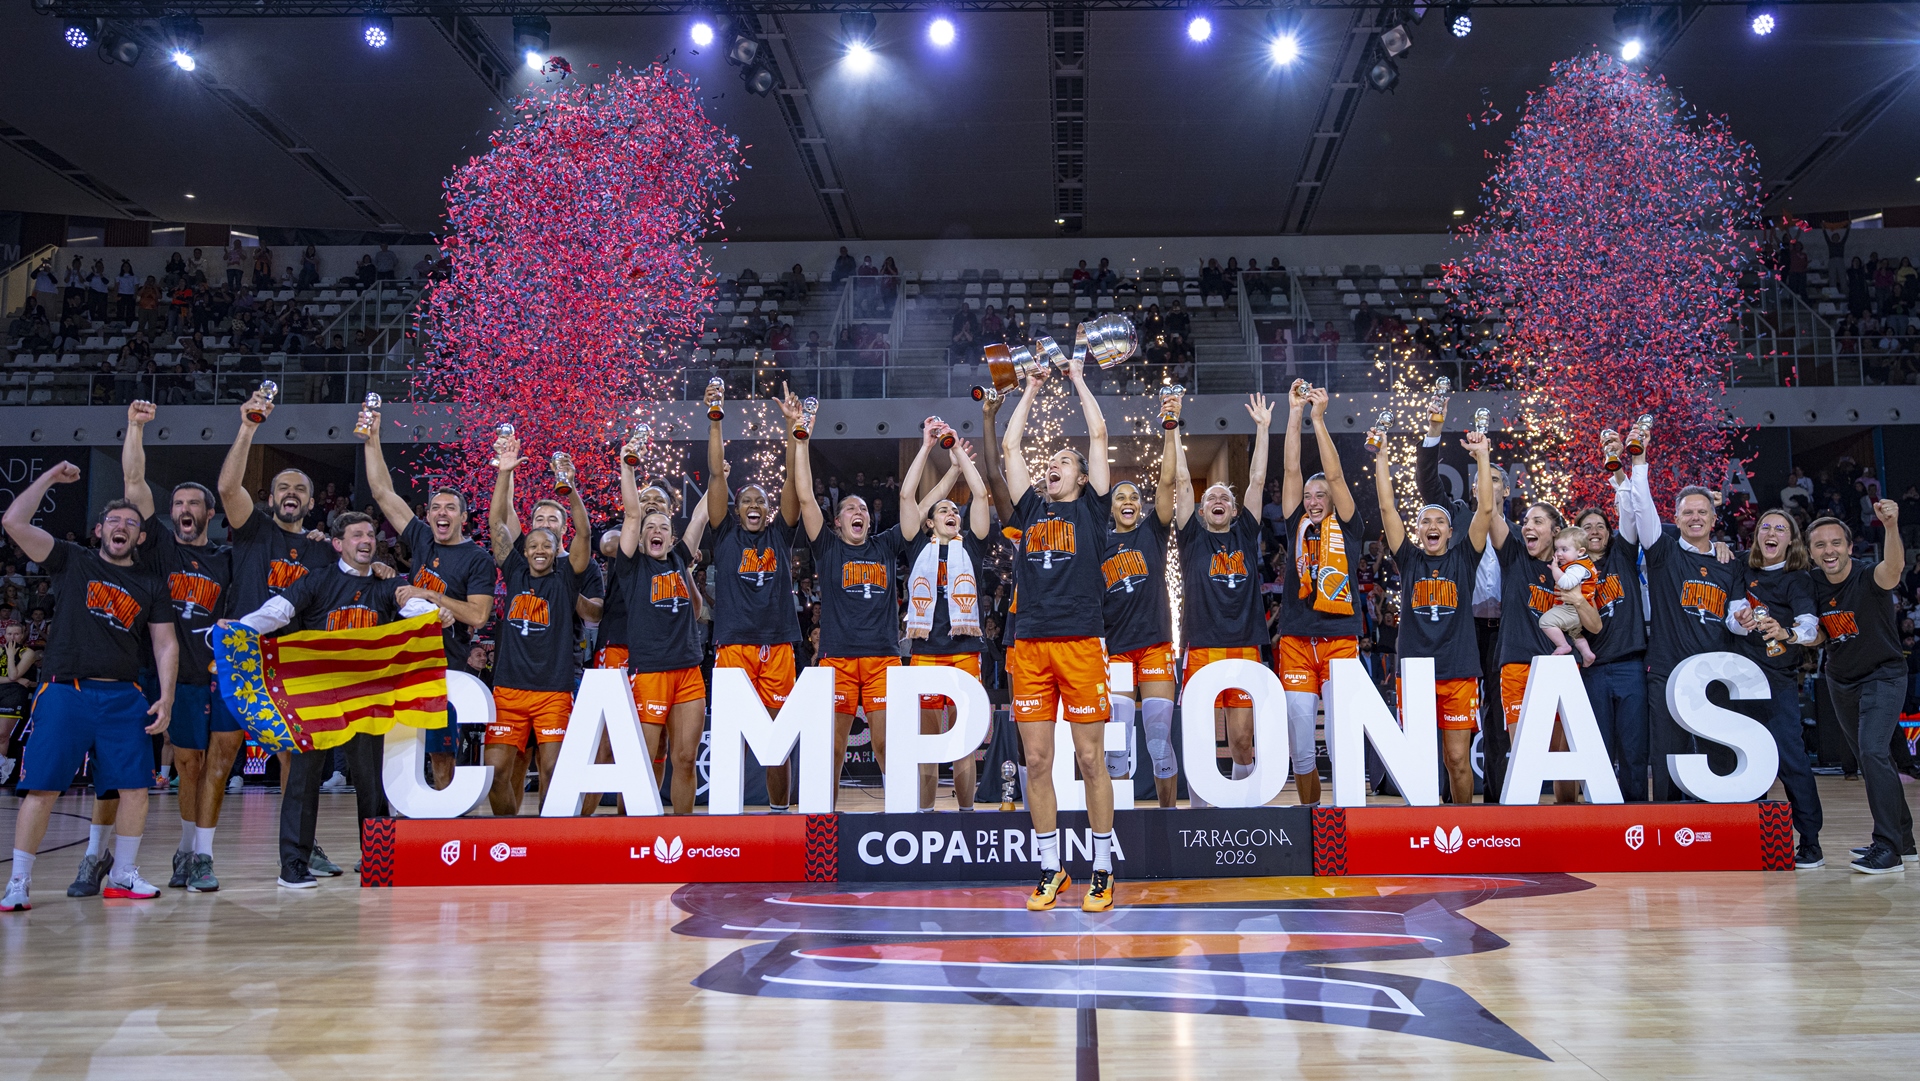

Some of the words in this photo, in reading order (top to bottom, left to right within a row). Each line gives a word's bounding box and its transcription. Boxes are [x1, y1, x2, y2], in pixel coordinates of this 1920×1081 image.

[1016, 699, 1039, 707] PULEVA
[382, 652, 1779, 819] CAMPEONAS
[488, 725, 511, 733] PULEVA
[1178, 828, 1293, 848] TARRAGONA
[1410, 836, 1430, 849] LF
[1467, 835, 1521, 848] endesa
[630, 847, 650, 859] LF
[687, 845, 740, 858] endesa
[857, 830, 973, 865] COPA
[976, 830, 998, 846] DE
[976, 848, 1000, 863] LA
[1215, 849, 1257, 865] 2026
